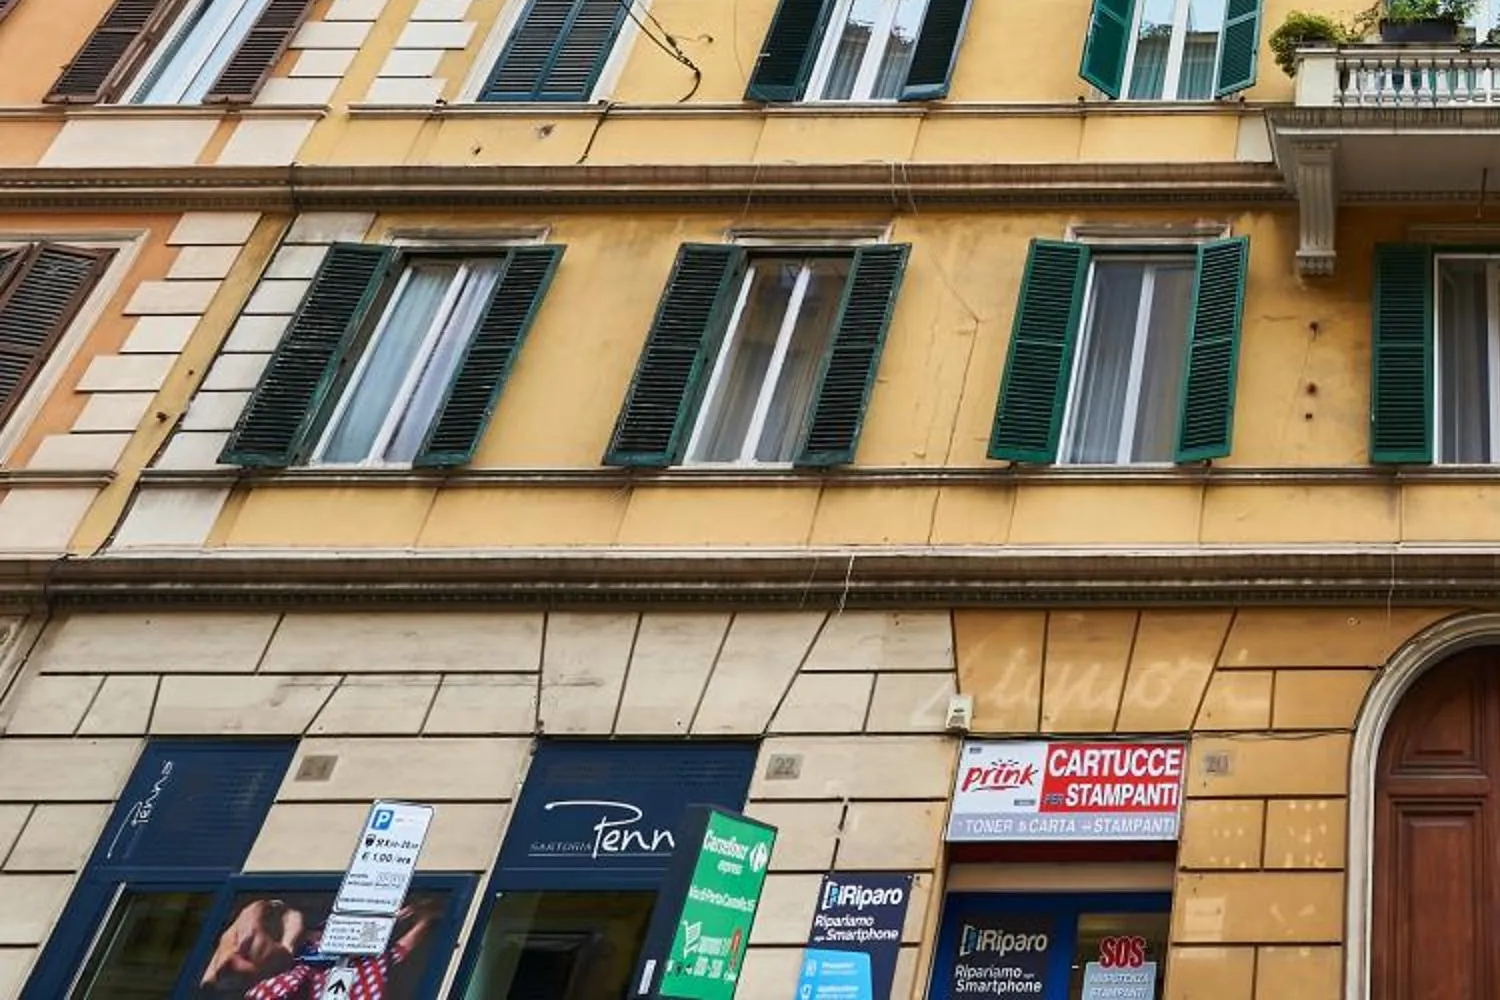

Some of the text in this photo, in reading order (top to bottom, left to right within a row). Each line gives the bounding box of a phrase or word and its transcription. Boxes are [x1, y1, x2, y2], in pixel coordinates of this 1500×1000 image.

[1048, 748, 1182, 778] CARTUCCE
[961, 760, 1039, 793] prink
[1065, 783, 1178, 808] STAMPANTI
[544, 800, 675, 860] Penn
[966, 818, 1013, 833] TONER
[1029, 818, 1076, 833] CARTA
[1093, 818, 1176, 834] STAMPANTI
[837, 884, 903, 911] iRiparo
[814, 914, 875, 930] Ripariamo
[826, 928, 899, 943] Smartphone
[976, 929, 1048, 957] iRiparo
[1099, 936, 1147, 969] SOS
[955, 964, 1022, 980] Ripariamo
[955, 979, 1042, 995] Smartphone
